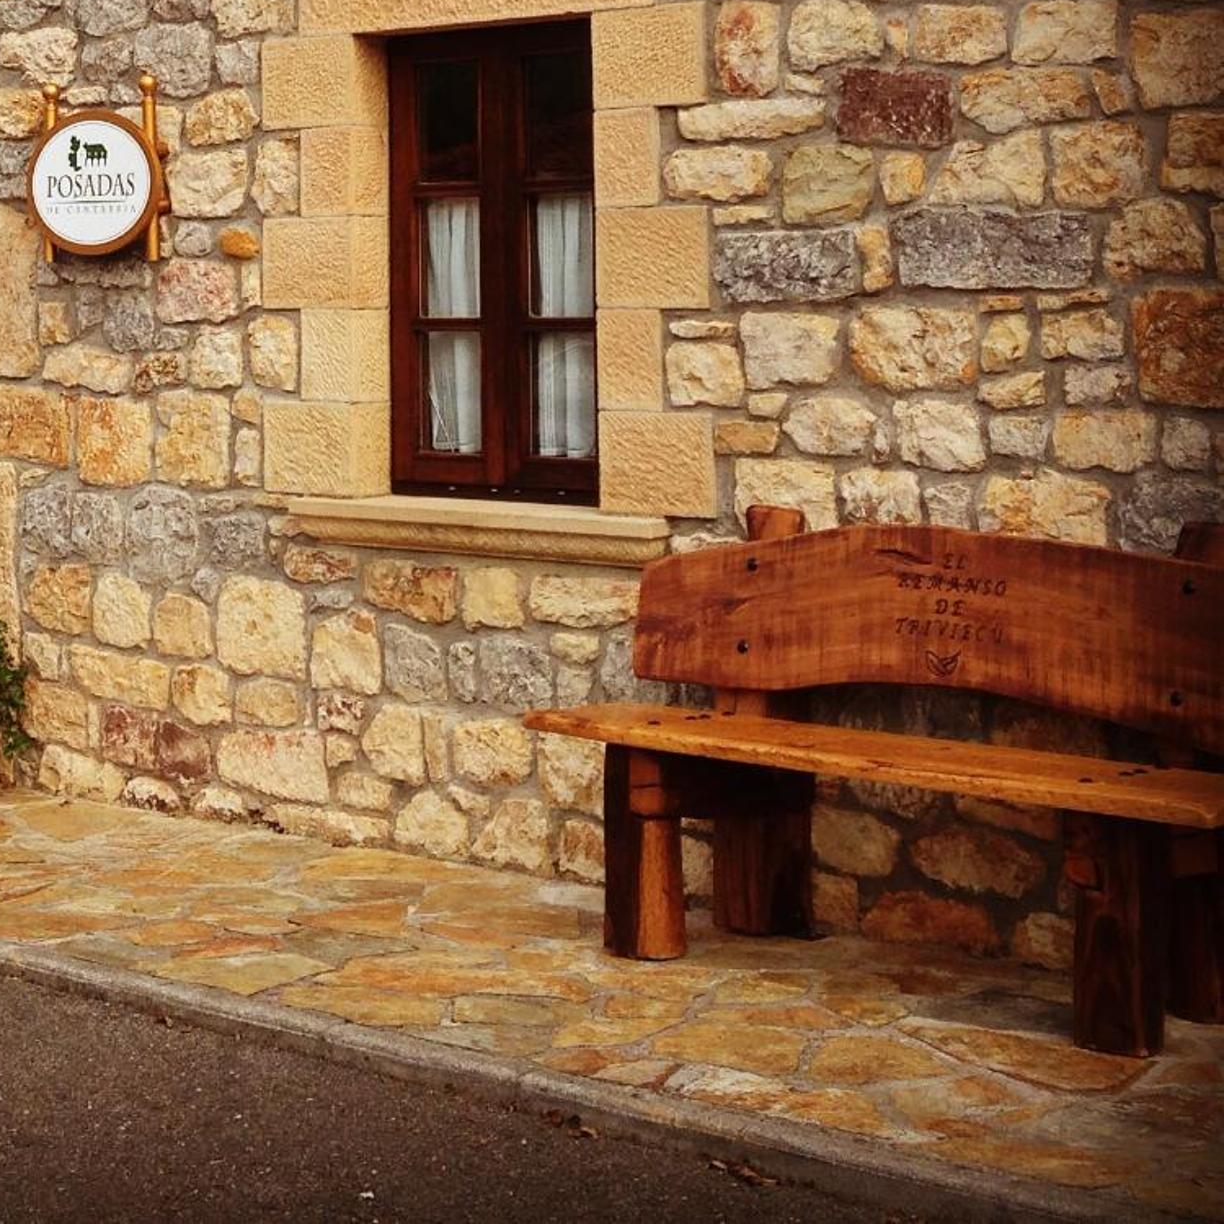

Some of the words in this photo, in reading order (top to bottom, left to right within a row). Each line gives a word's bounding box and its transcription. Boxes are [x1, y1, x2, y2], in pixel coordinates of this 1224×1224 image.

[47, 173, 136, 198] POSADAS
[943, 553, 967, 570] EL
[898, 573, 1007, 596] REMANSO
[935, 599, 967, 615] DE
